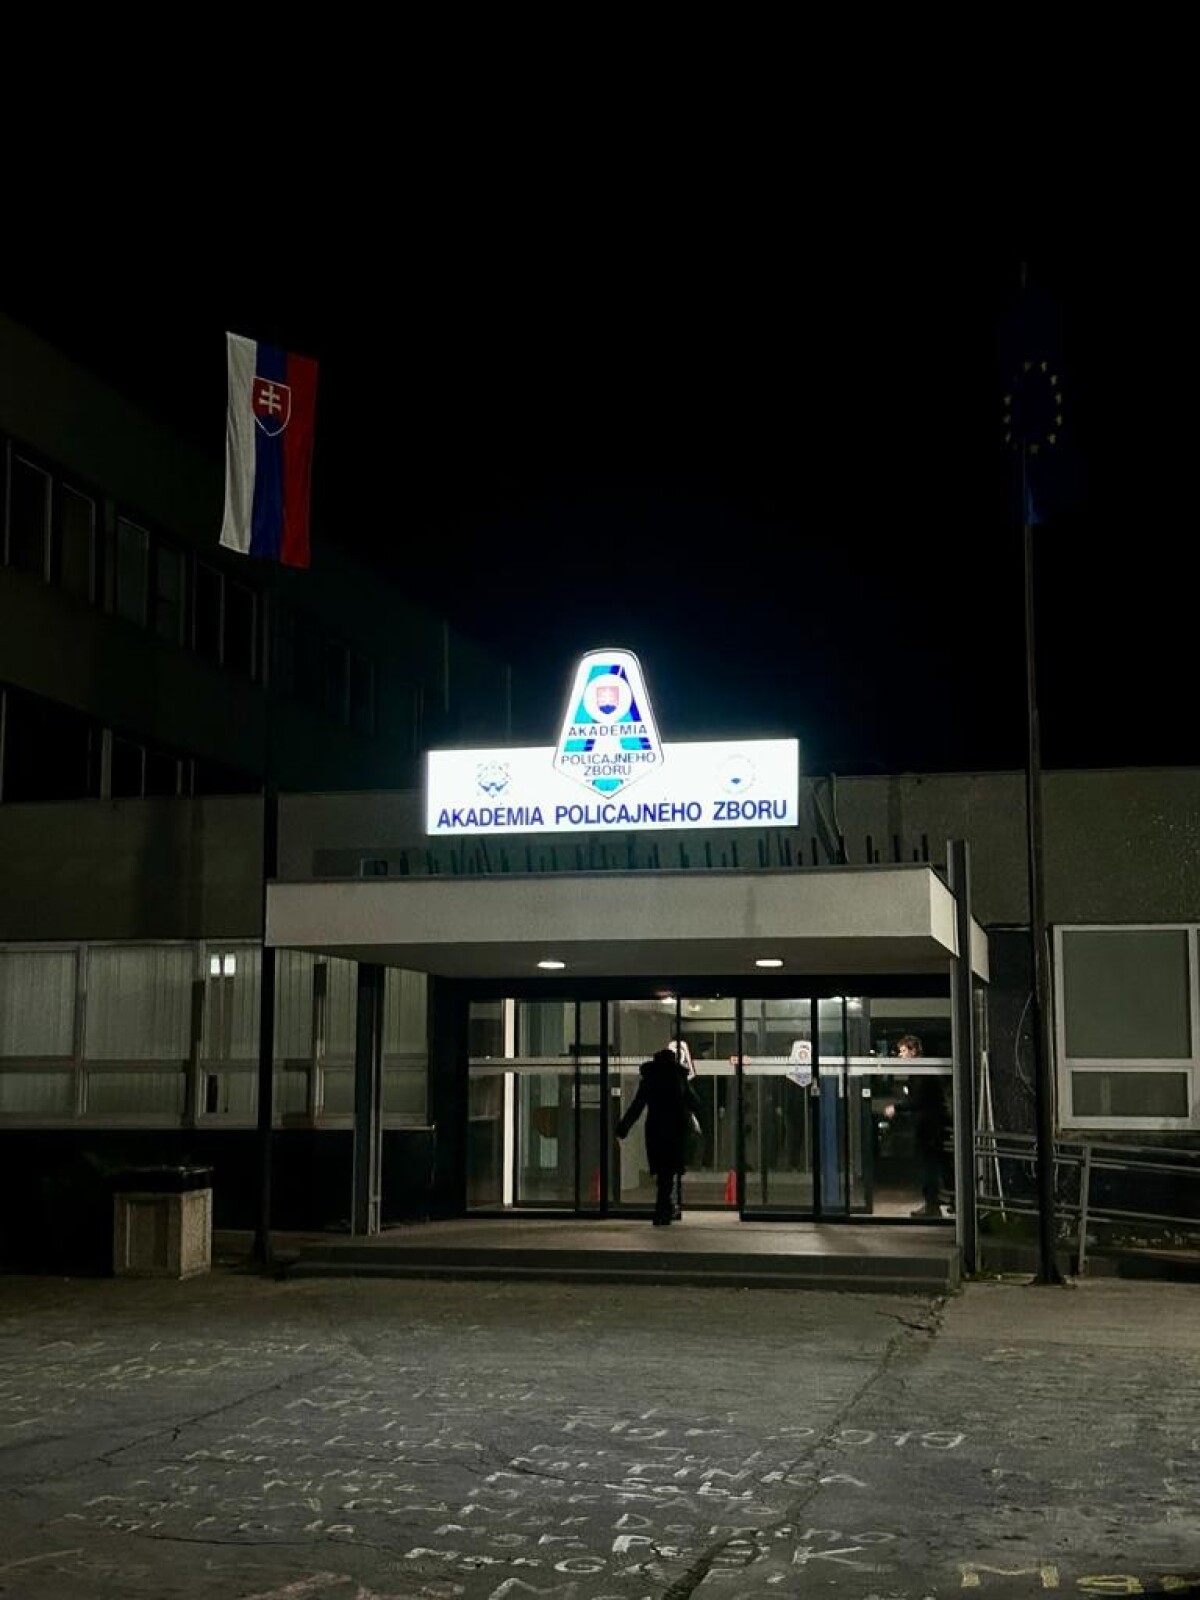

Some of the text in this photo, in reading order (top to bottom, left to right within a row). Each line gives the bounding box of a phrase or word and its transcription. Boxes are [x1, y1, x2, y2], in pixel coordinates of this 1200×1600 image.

[568, 725, 647, 736] AKADEMIA
[583, 765, 632, 776] ZBORU
[713, 800, 787, 821] ZBORU
